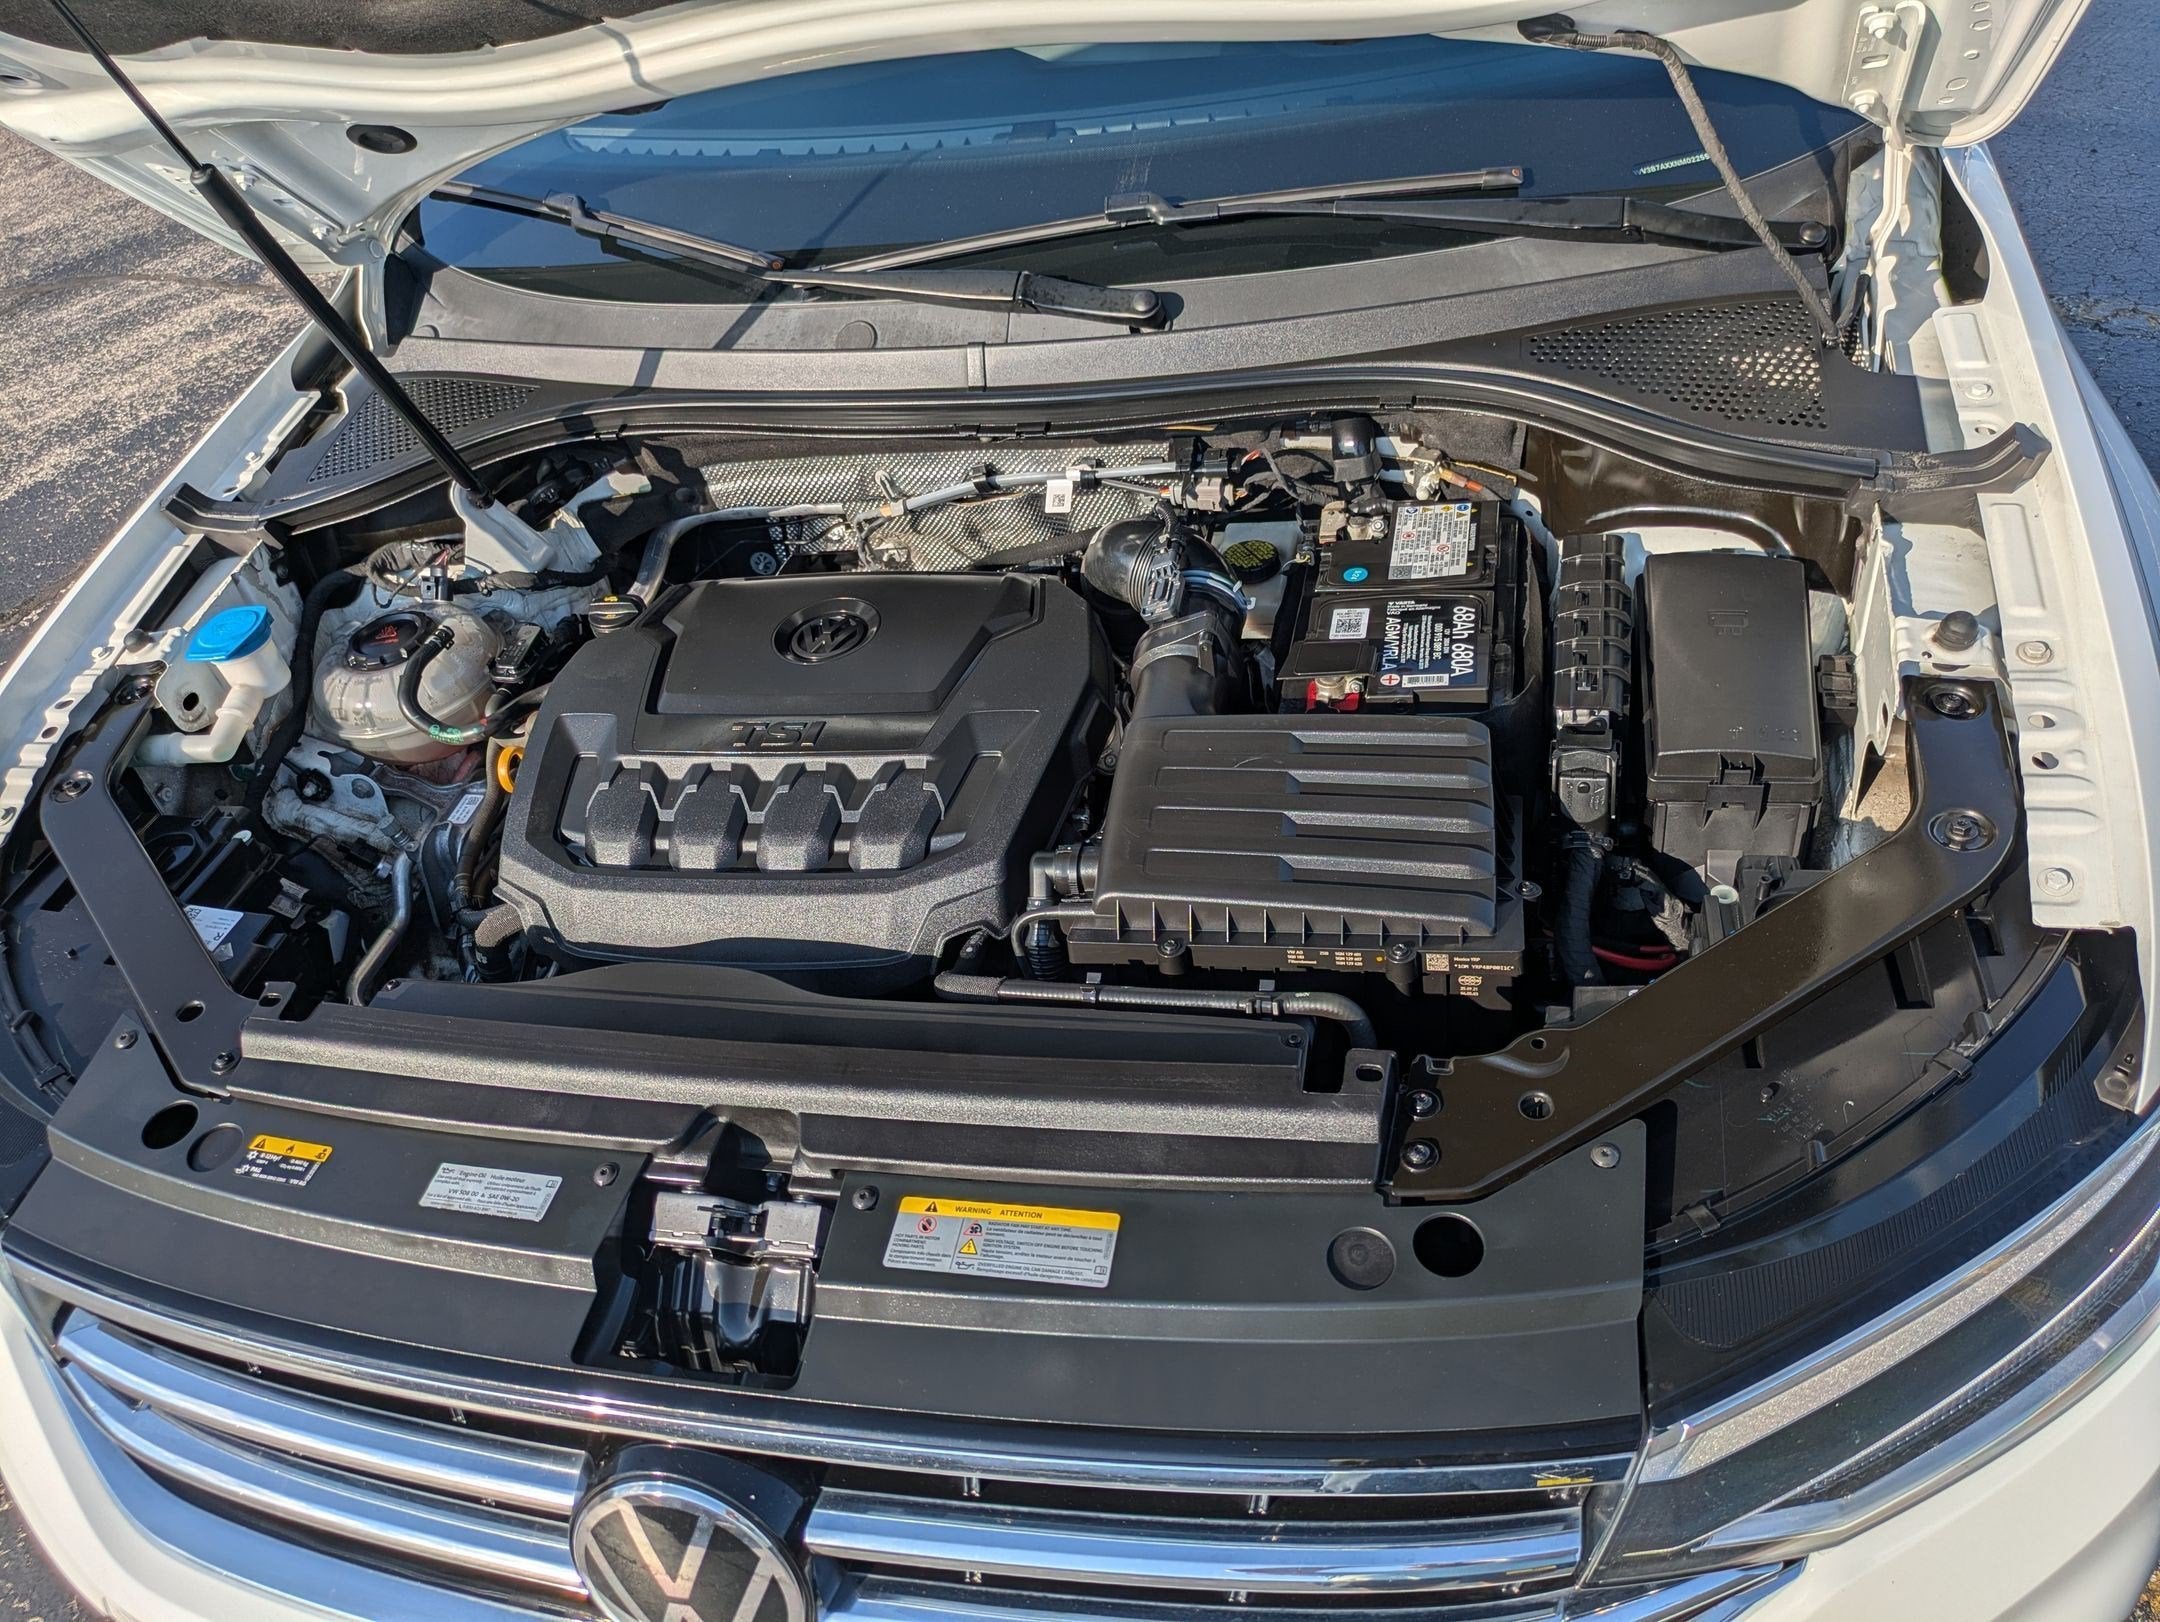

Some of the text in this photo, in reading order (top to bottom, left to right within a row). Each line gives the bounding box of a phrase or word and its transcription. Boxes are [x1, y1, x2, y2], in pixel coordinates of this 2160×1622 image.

[1381, 617, 1402, 671] AGM/VRLA
[1450, 605, 1476, 677] 68Ah 680A
[731, 721, 827, 747] TSI
[955, 1206, 1042, 1218] WARNING ATTENTION
